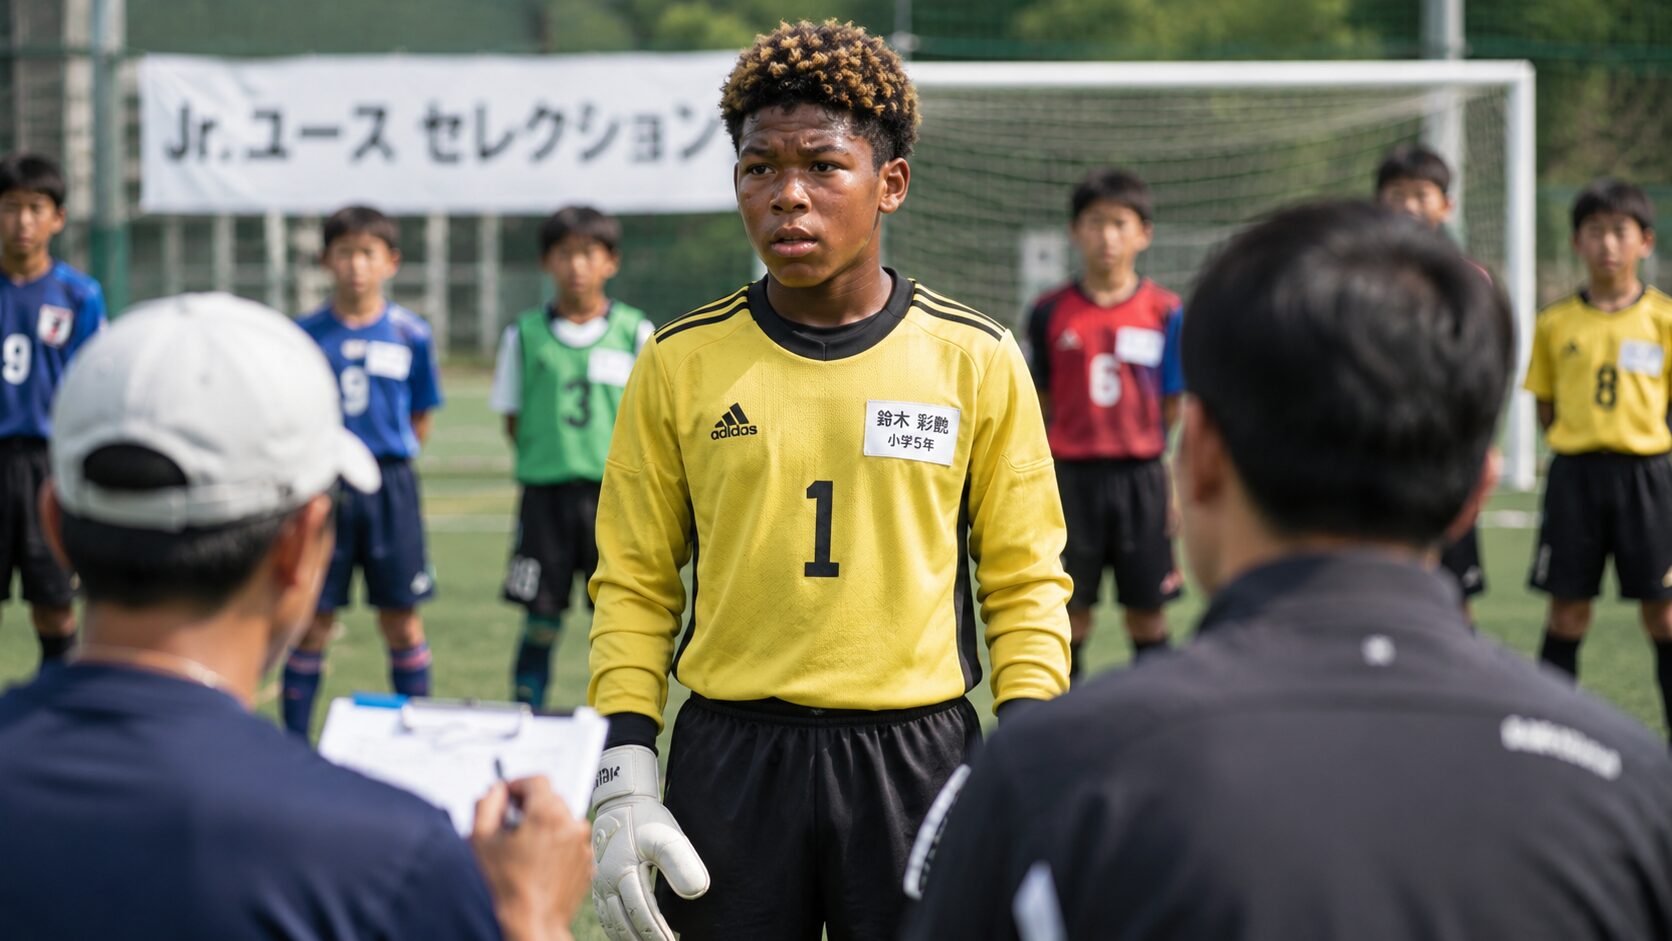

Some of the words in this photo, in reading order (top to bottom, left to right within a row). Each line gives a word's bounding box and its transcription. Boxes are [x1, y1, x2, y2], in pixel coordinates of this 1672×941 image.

[422, 101, 720, 162] セレクション
[1, 332, 33, 386] 9
[1089, 352, 1121, 408] 6
[341, 365, 369, 417] 9
[564, 377, 592, 428] 3
[1594, 363, 1618, 412] 8
[710, 425, 758, 440] adidas
[877, 409, 910, 428] 鈴木
[888, 433, 935, 452] 小学5年
[804, 480, 840, 578] 1
